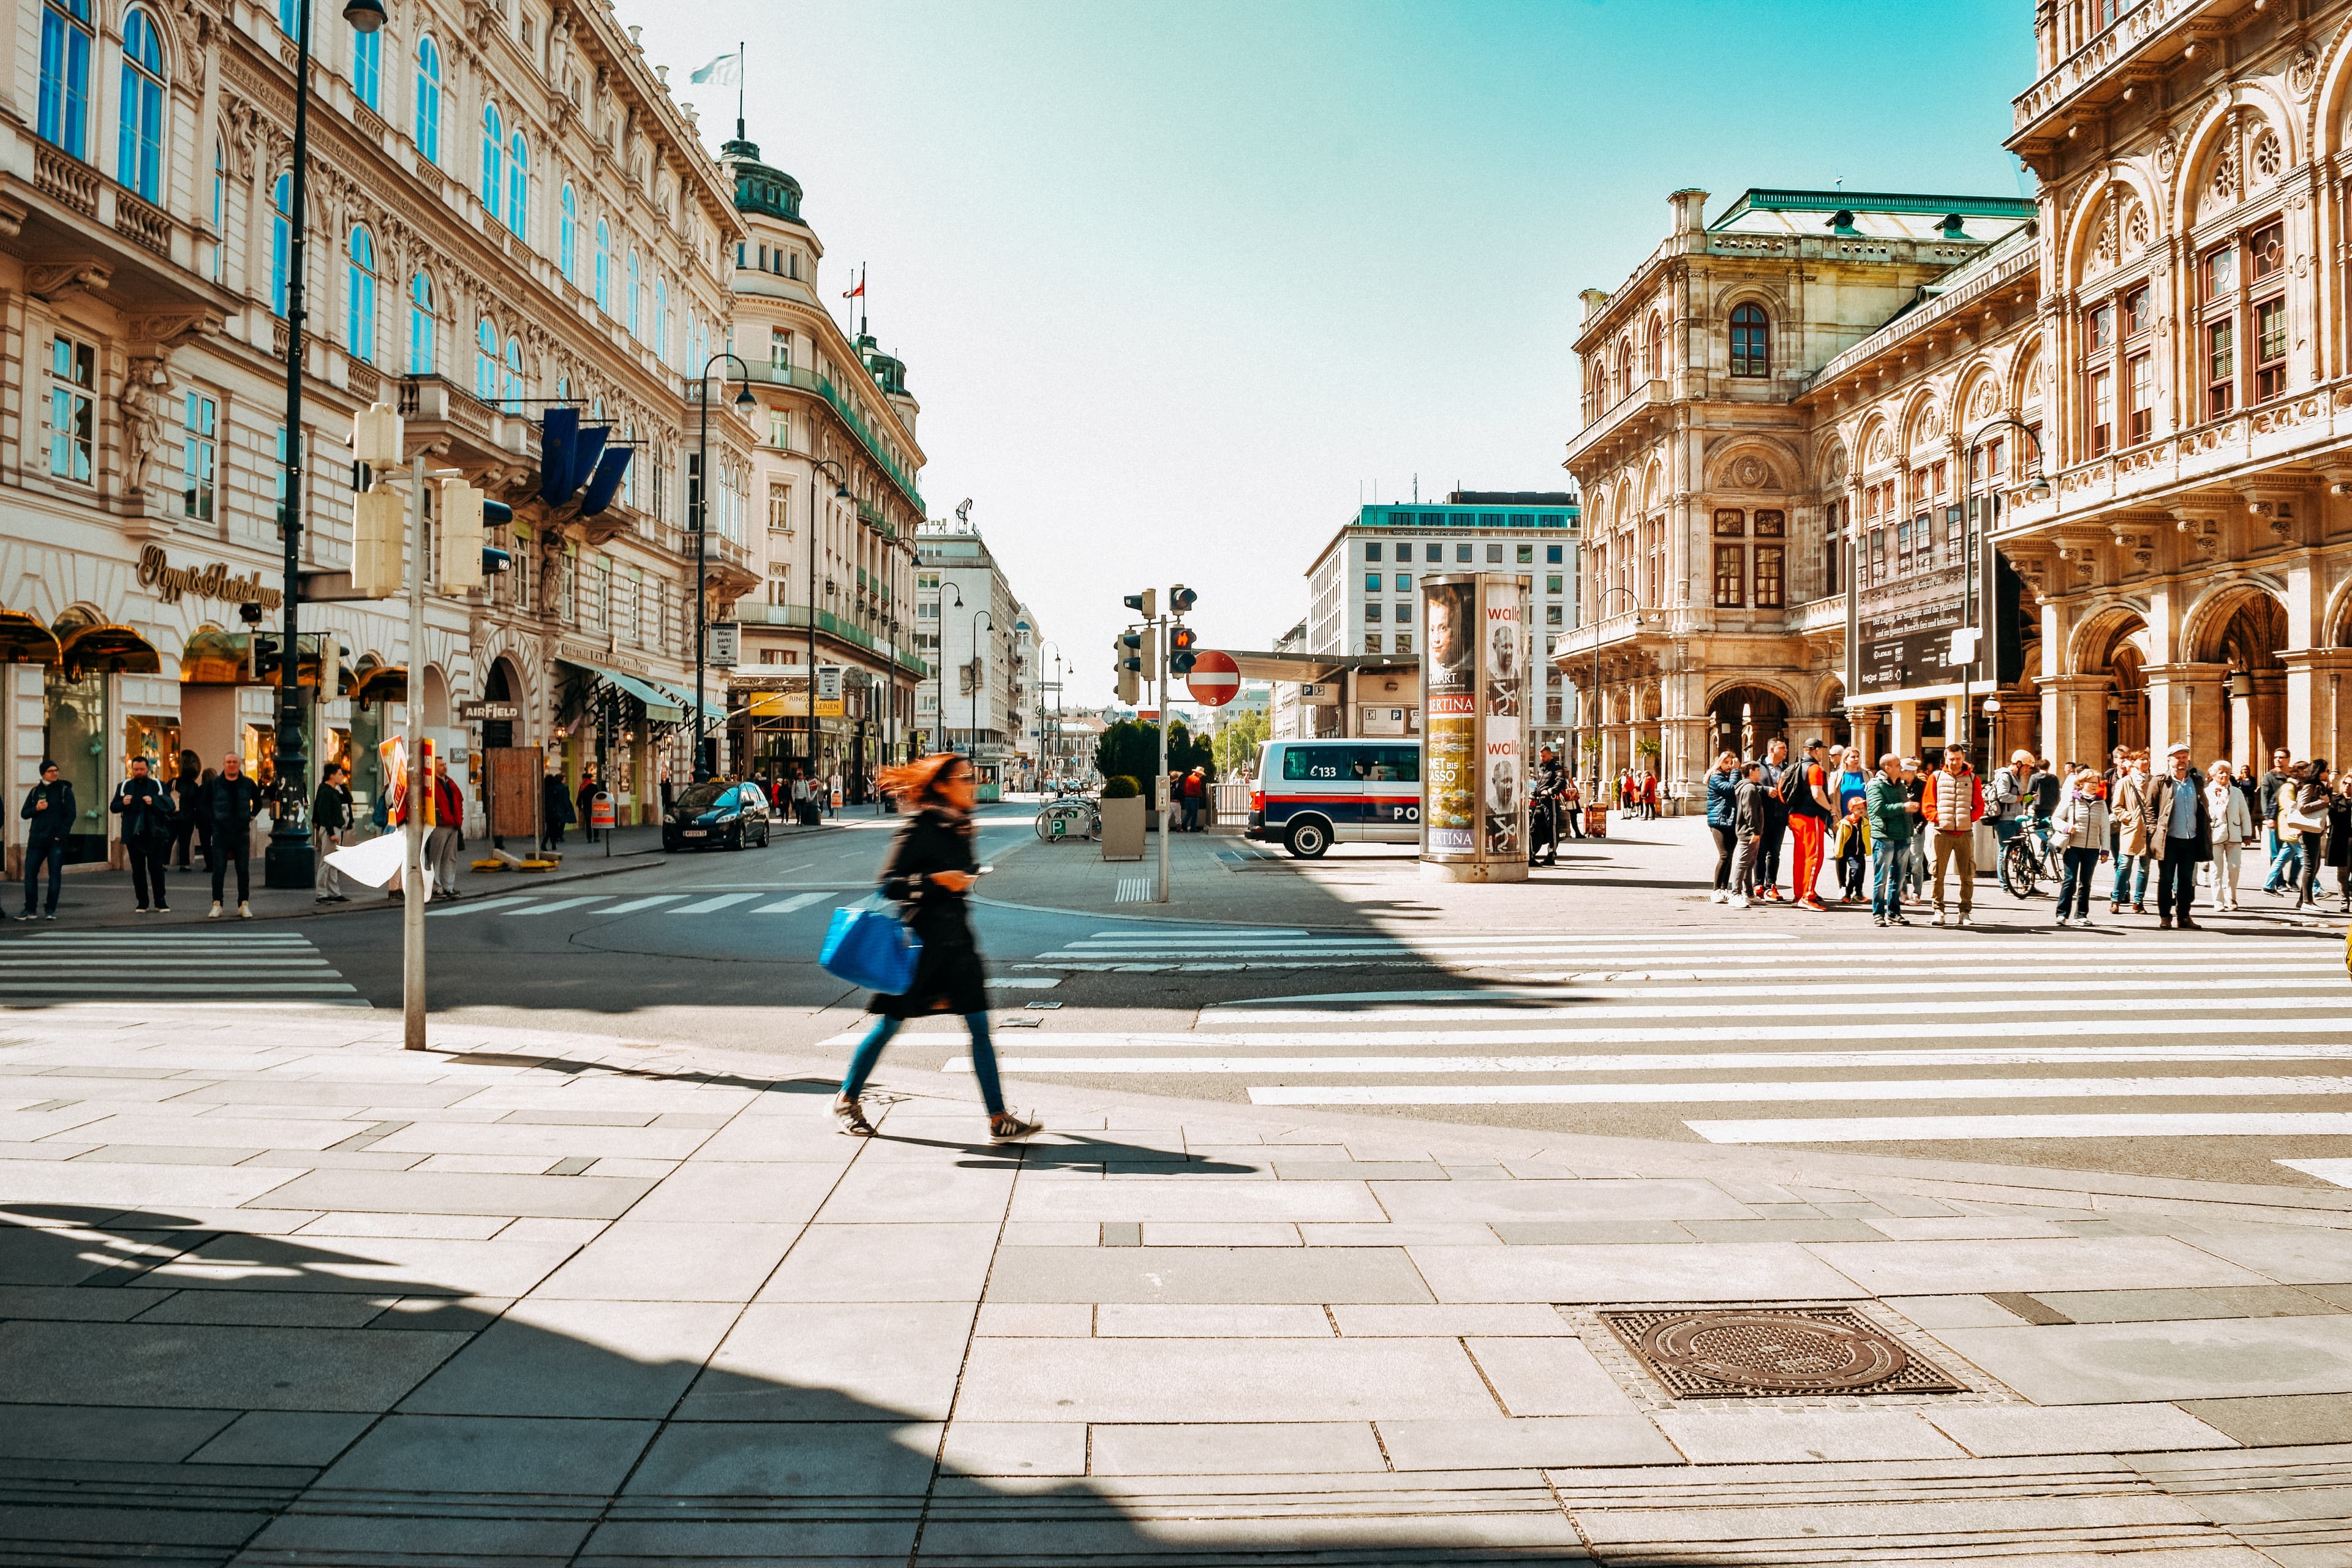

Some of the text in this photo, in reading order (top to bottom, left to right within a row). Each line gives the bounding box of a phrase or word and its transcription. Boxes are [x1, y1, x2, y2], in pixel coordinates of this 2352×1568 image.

[500, 559, 509, 570] 22
[1319, 766, 1336, 777] 133
[1053, 821, 1063, 834] P
